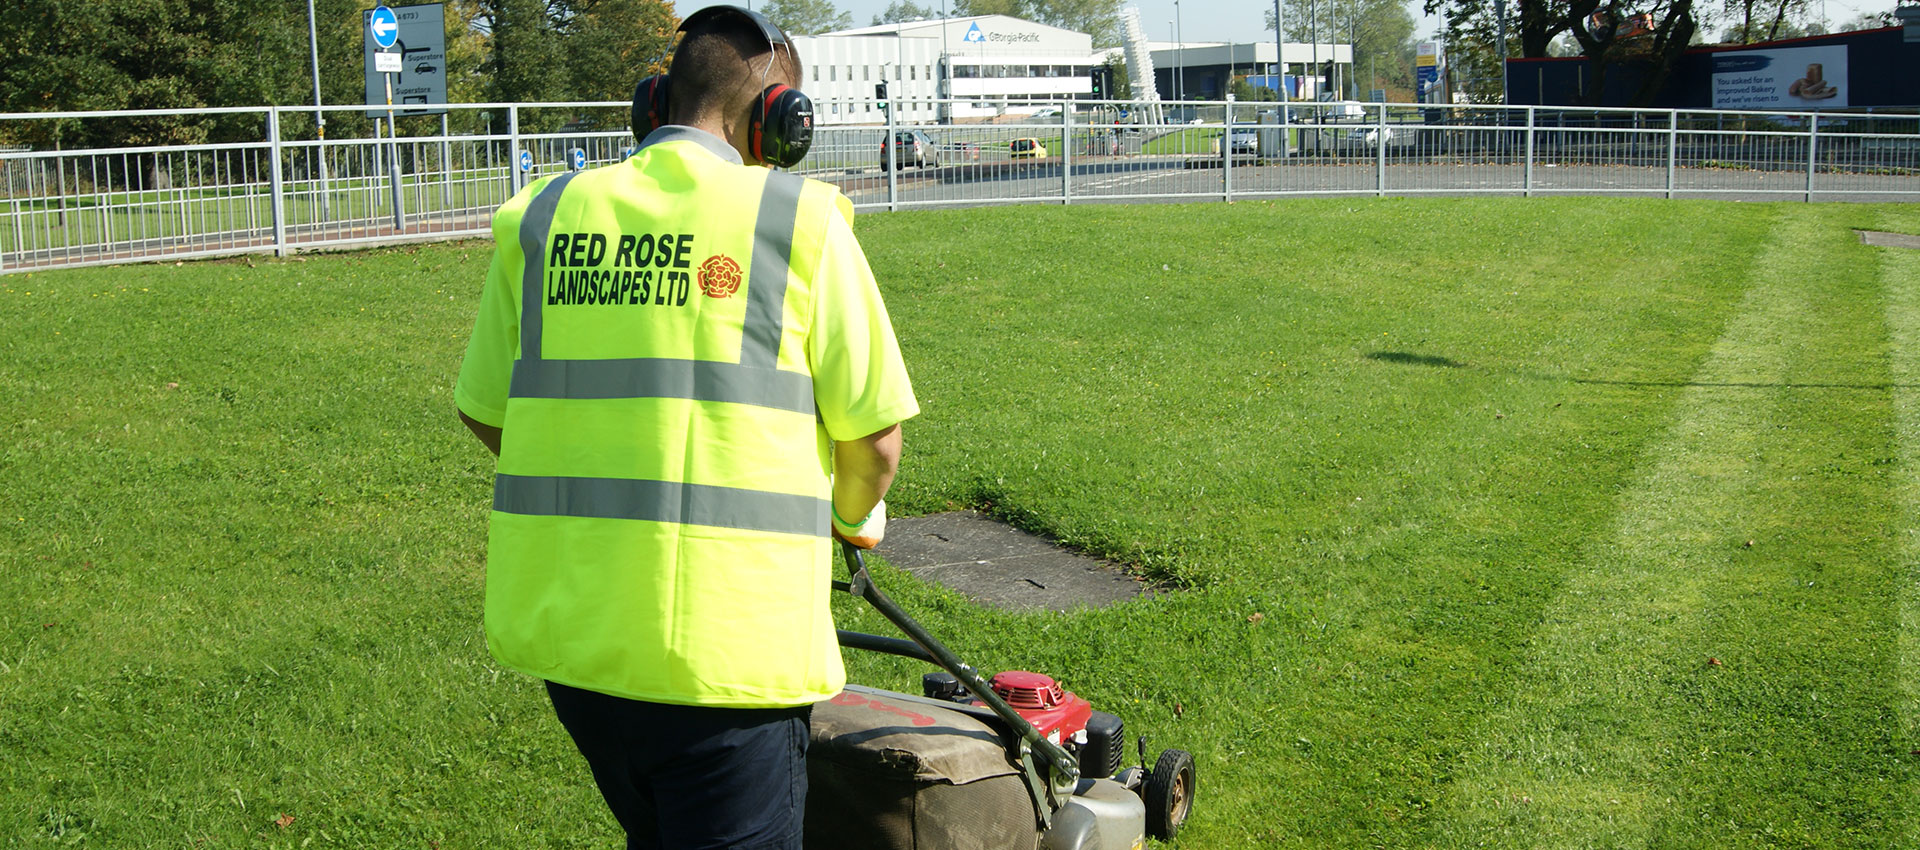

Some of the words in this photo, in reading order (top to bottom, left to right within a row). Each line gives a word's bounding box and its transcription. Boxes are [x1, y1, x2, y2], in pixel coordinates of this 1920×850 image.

[989, 32, 1040, 44] Georgia-Pacific
[407, 54, 443, 62] Superstore
[395, 87, 431, 95] Superstore
[1751, 86, 1776, 94] Bakery
[550, 233, 607, 268] RED
[614, 234, 694, 269] ROSE
[547, 270, 652, 306] LANDSCAPES
[654, 271, 690, 307] LTD
